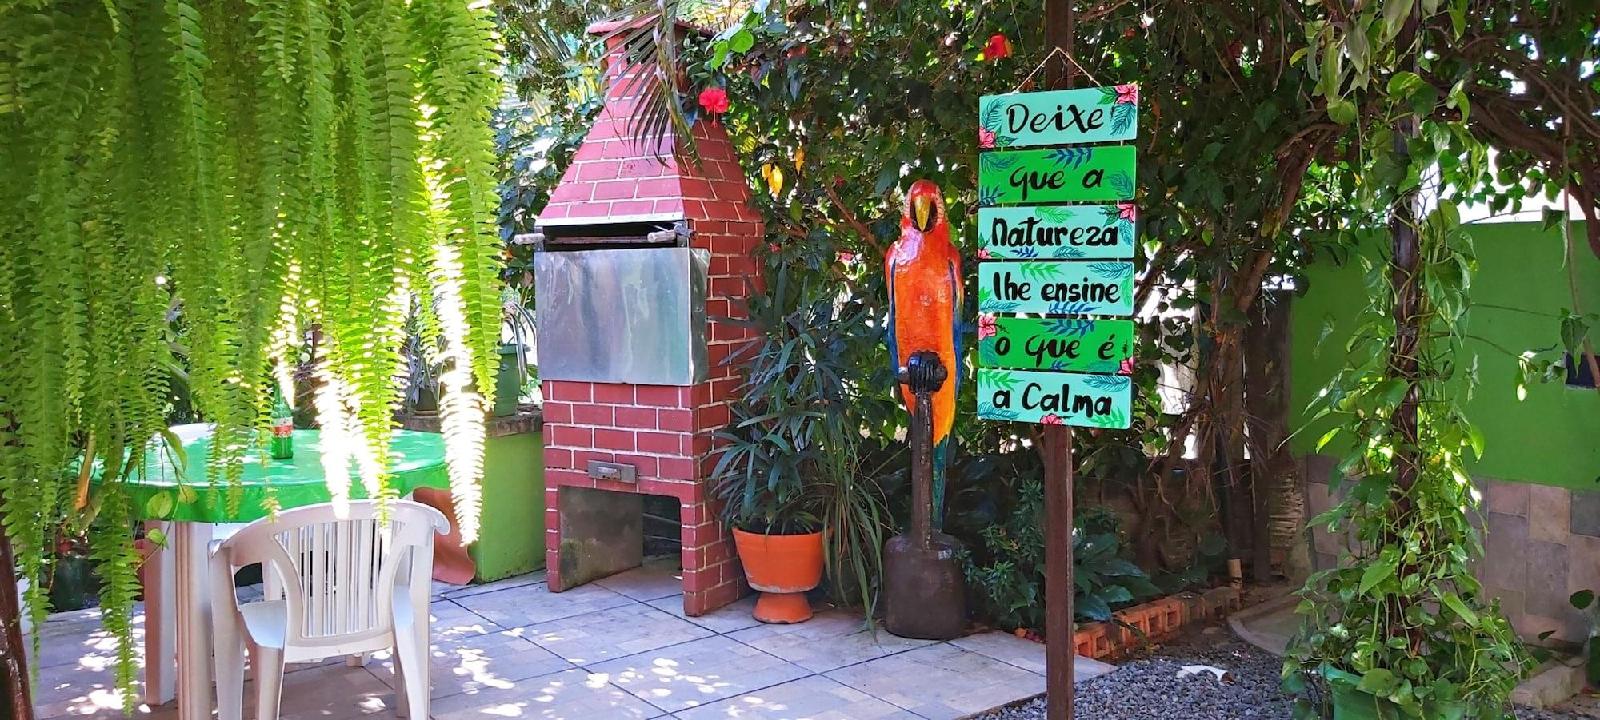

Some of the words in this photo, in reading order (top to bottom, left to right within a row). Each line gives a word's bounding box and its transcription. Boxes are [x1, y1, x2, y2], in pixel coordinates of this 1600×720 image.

[1006, 103, 1104, 134] Deixe
[1009, 166, 1066, 201] que
[1082, 168, 1104, 189] a
[993, 271, 1032, 301] lhe
[1040, 276, 1121, 303] ensine
[994, 336, 1011, 356] o
[1024, 334, 1080, 368] que
[1097, 333, 1115, 360] é
[992, 389, 1011, 409] a
[1021, 382, 1112, 418] Calma
